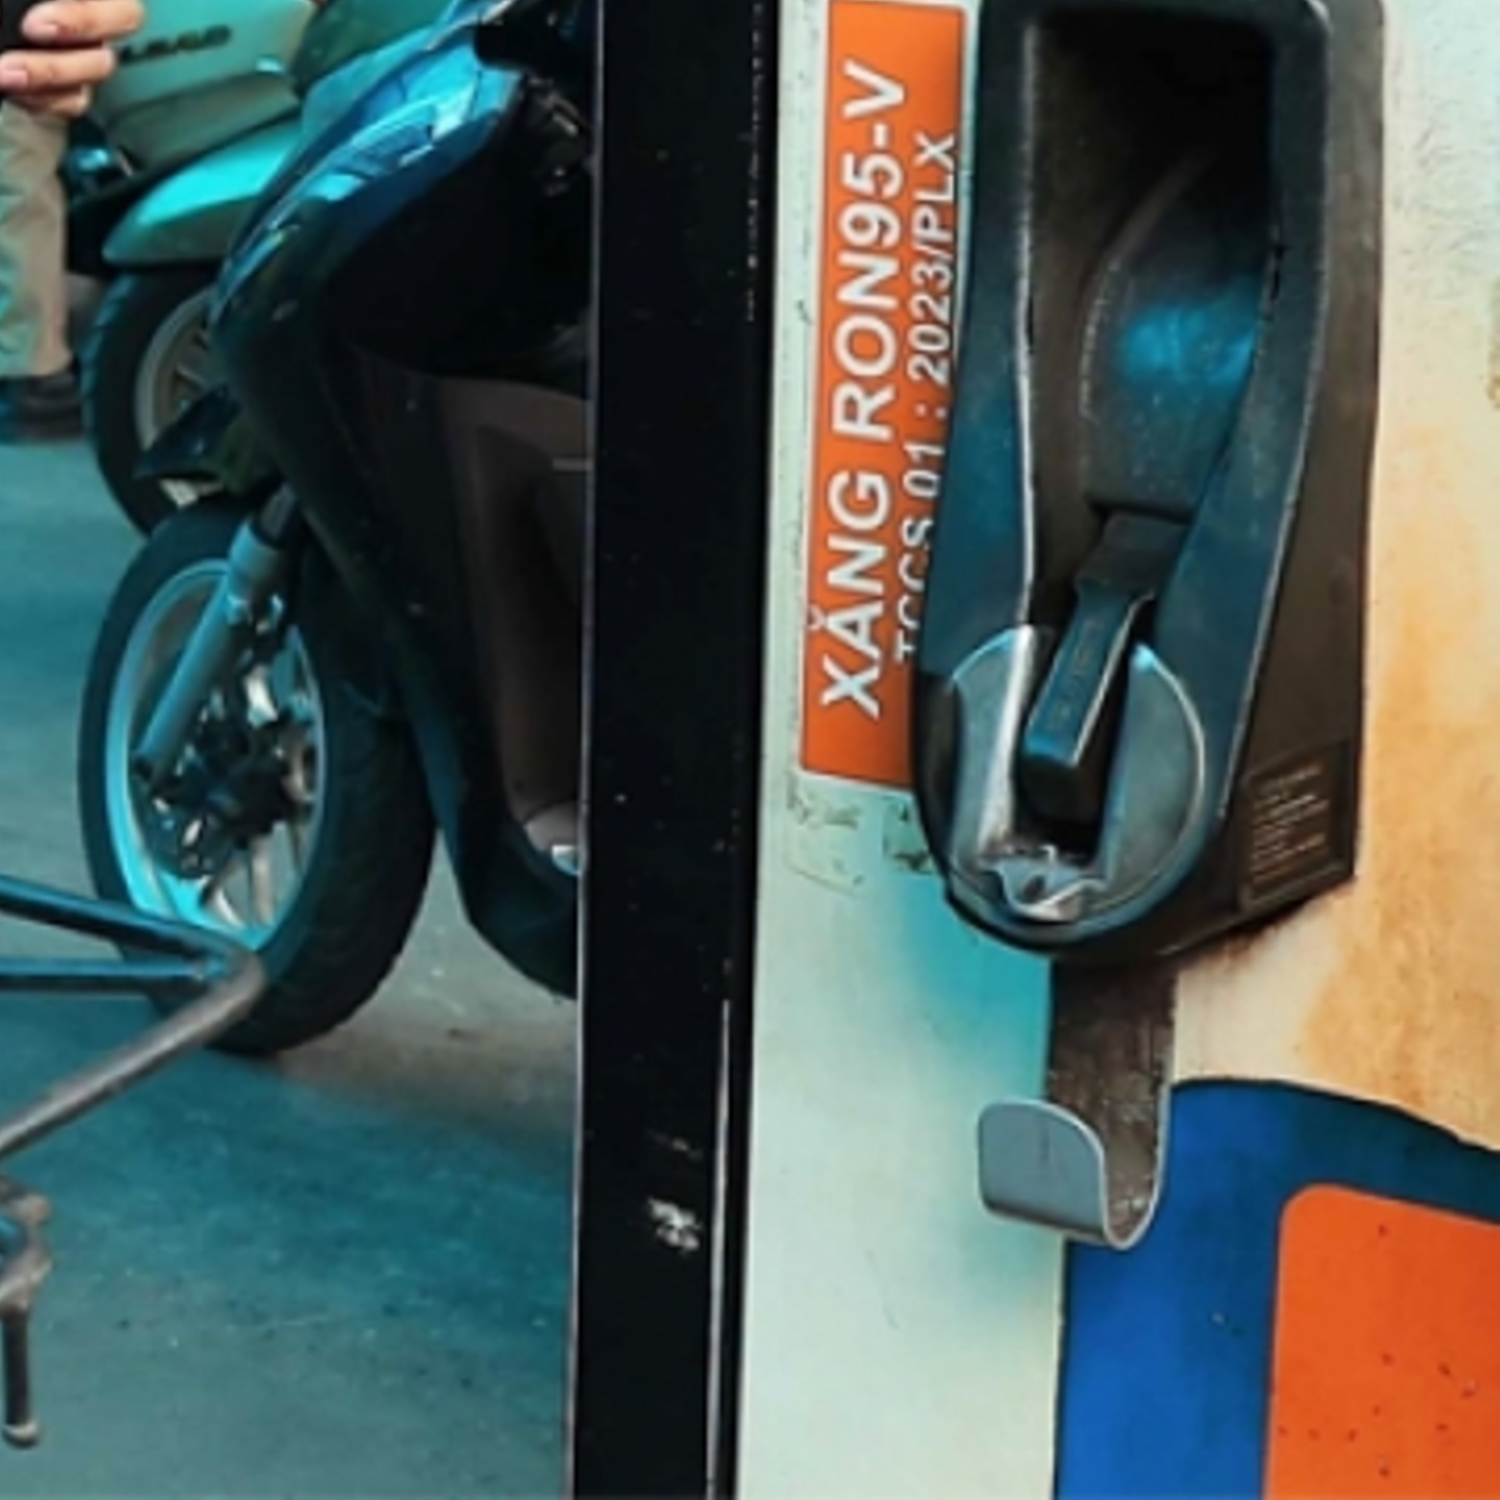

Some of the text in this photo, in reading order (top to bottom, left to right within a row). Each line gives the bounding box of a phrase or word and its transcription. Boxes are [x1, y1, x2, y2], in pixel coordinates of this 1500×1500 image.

[907, 131, 956, 387] 2023/PLX
[808, 59, 906, 721] XĂNG RON95-V
[902, 440, 944, 498] 01
